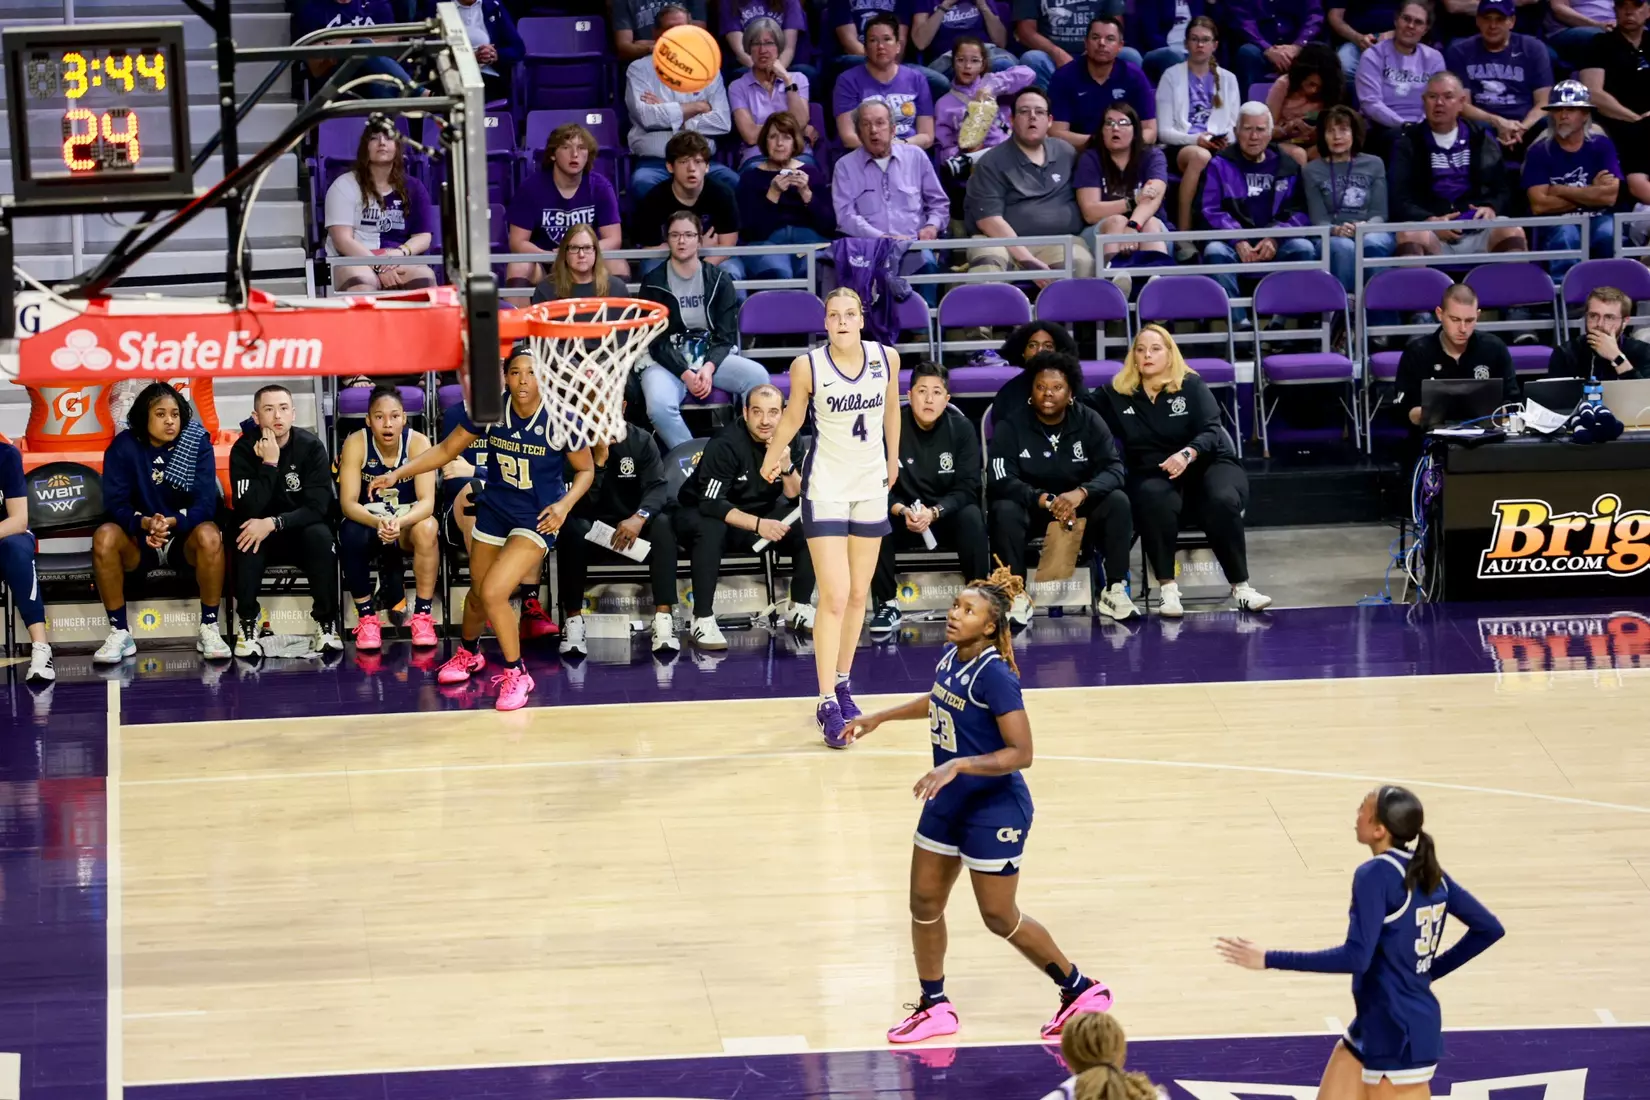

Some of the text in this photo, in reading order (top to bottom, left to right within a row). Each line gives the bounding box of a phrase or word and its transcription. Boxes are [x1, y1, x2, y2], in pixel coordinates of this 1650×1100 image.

[658, 42, 694, 75] Wilson
[62, 53, 166, 99] 3:44
[63, 108, 140, 170] 24
[542, 207, 595, 226] K-STATE
[58, 391, 83, 418] G
[826, 393, 883, 413] Wildcats
[852, 413, 868, 443] 4
[489, 435, 546, 456] GEORGIA TECH
[496, 452, 533, 491] 21
[36, 485, 84, 501] WBIT
[1484, 555, 1604, 574] AUTO.COM
[713, 587, 759, 600] UNGER FREE
[53, 616, 107, 628] HUNGER FREE
[164, 612, 197, 624] HUNGER
[271, 610, 303, 621] HUNGER
[944, 691, 967, 711] TECH
[928, 698, 958, 753] 23
